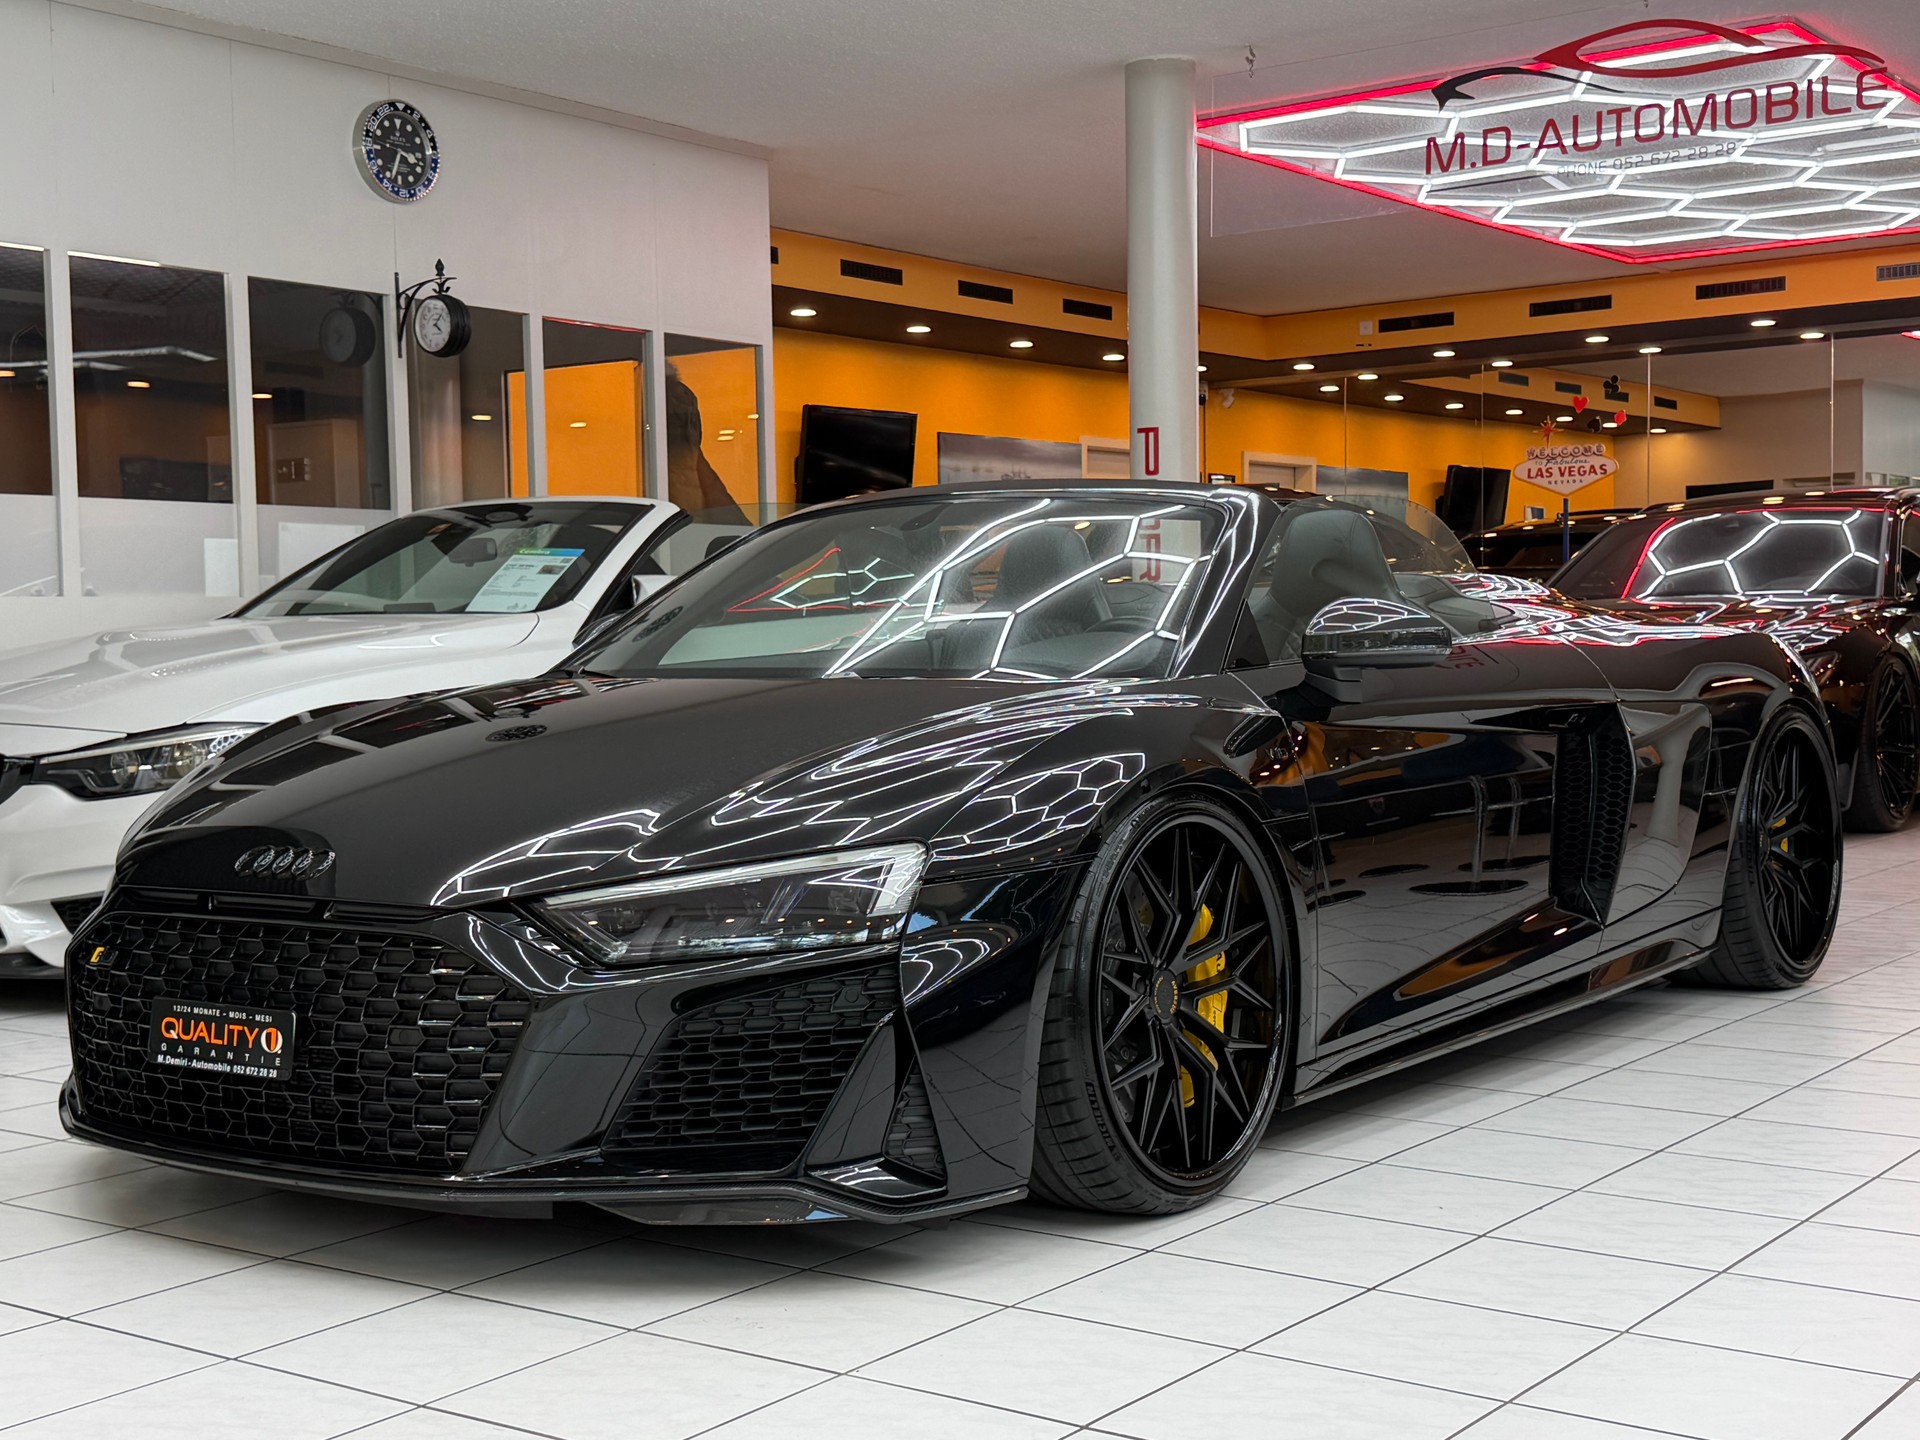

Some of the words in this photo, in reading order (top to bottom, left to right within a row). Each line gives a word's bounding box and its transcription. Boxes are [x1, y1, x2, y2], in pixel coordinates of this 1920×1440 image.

[377, 104, 390, 115] 22
[413, 111, 421, 120] 2
[367, 117, 377, 131] 20
[1425, 67, 1888, 175] M.D-AUTOMOBILE
[426, 130, 434, 138] 4
[1556, 160, 1606, 177] PHONE
[1613, 155, 1643, 170] 052
[1651, 150, 1680, 165] 672
[1687, 145, 1708, 160] 28
[1715, 141, 1737, 156] 28
[369, 159, 379, 174] 16
[382, 178, 393, 191] 14
[399, 188, 410, 198] 12
[1526, 443, 1605, 460] WELCOME
[1544, 457, 1590, 467] Fabulous
[1527, 466, 1553, 479] LAS
[1557, 463, 1608, 478] VEGAS
[193, 1007, 221, 1017] MONATE
[228, 1011, 247, 1020] MOIS
[255, 1014, 272, 1023] MESI
[161, 1017, 259, 1049] QUALITY
[161, 1042, 281, 1066] GARANTIE
[233, 1067, 245, 1075] 052
[246, 1068, 258, 1076] 672
